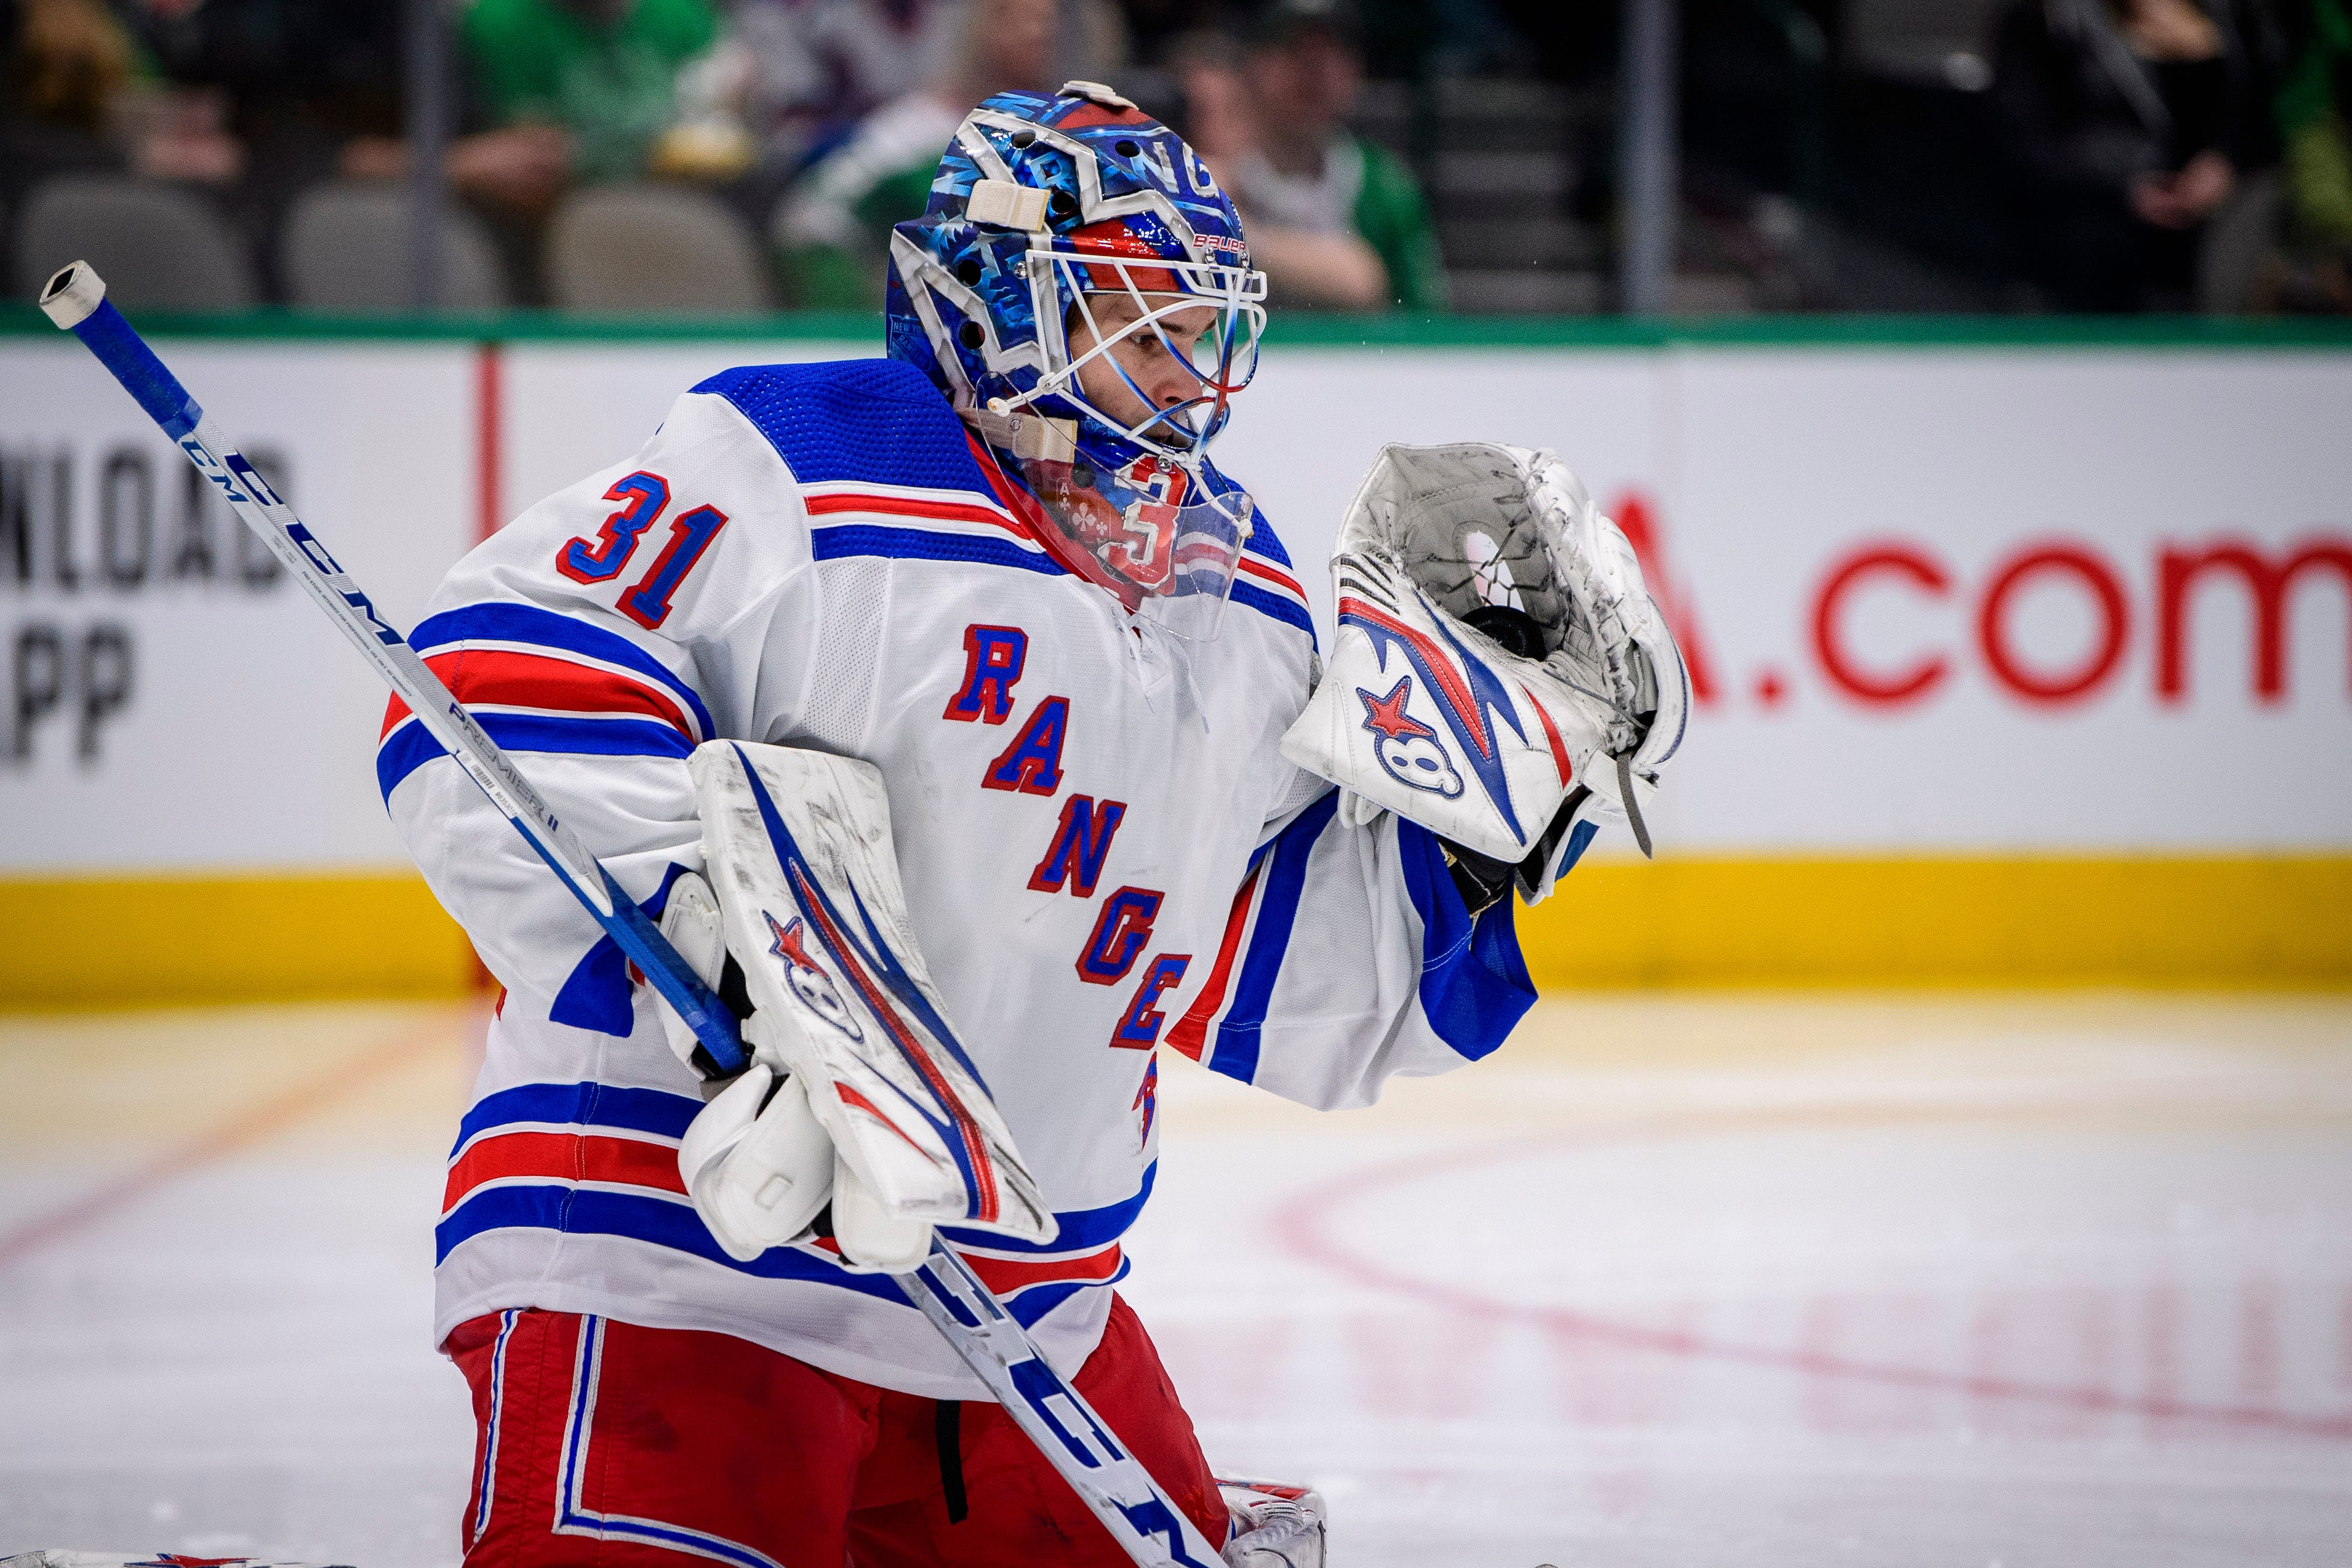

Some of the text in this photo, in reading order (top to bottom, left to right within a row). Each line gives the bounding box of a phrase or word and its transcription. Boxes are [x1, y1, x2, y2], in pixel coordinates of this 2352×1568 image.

[893, 321, 910, 332] NEW
[224, 449, 406, 646] CCM
[556, 470, 730, 631] 31
[1059, 482, 1070, 496] A
[302, 571, 311, 581] PRO
[321, 594, 340, 614] INTENDED
[338, 613, 347, 623] FOR
[345, 621, 370, 650] PROFESSIONAL
[370, 650, 378, 659] USE
[386, 668, 393, 676] NO
[392, 675, 412, 697] WARRANTY
